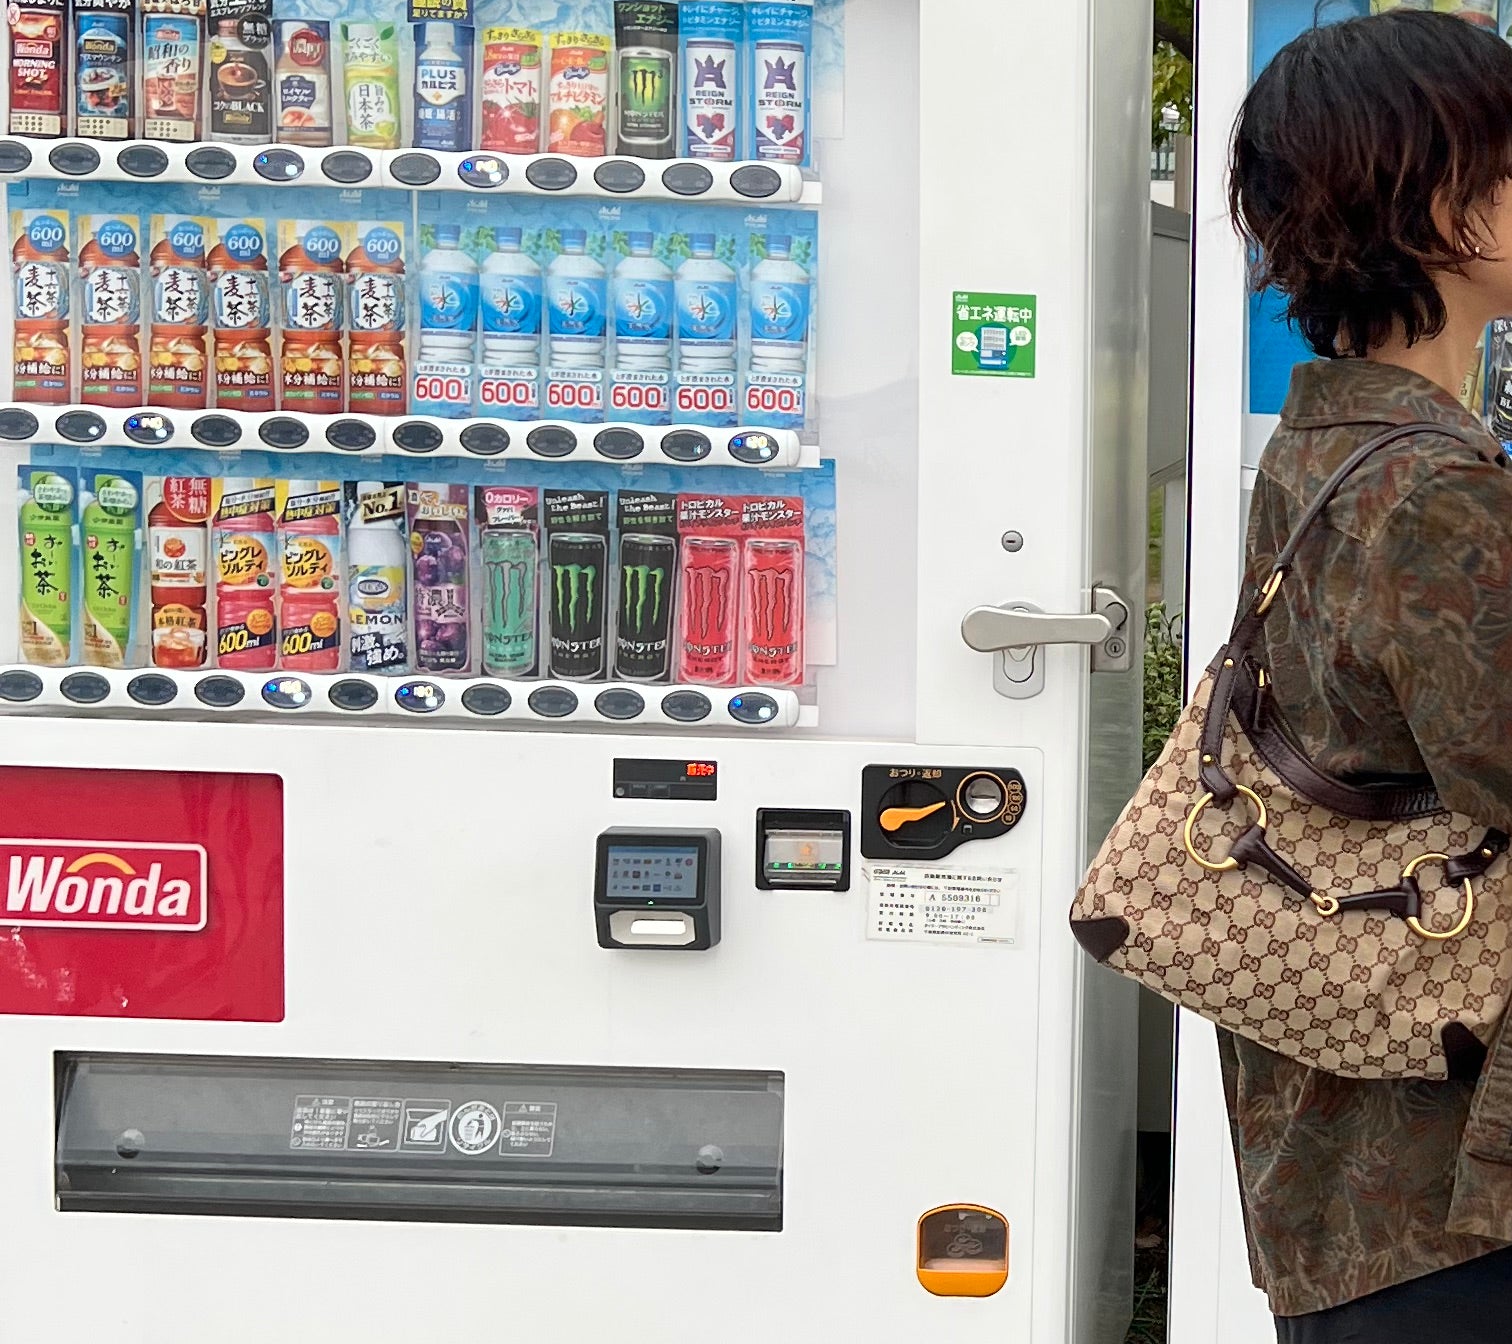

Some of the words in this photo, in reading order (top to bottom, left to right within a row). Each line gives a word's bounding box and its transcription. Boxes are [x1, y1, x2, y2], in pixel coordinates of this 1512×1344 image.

[421, 70, 456, 80] PLUS
[31, 227, 63, 242] 600
[101, 231, 133, 246] 600
[173, 232, 204, 247] 600
[227, 236, 260, 251] 600
[307, 238, 340, 253] 600
[366, 238, 399, 254] 600
[25, 265, 48, 317] 麦茶
[94, 270, 117, 321] 麦茶
[164, 271, 187, 322] 麦茶
[225, 274, 248, 325] 麦茶
[300, 276, 324, 327] 麦茶
[360, 276, 383, 327] 麦茶
[416, 377, 462, 401] 600
[481, 381, 529, 405] 600
[548, 383, 596, 407] 600
[612, 384, 659, 408] 600
[677, 387, 725, 410] 600
[747, 387, 795, 411] 600
[169, 479, 186, 509] 紅茶
[362, 490, 400, 518] No.1
[485, 493, 529, 504] 0カロリー
[30, 549, 58, 595] お茶
[92, 551, 119, 599] お茶
[6, 856, 191, 917] Wonda
